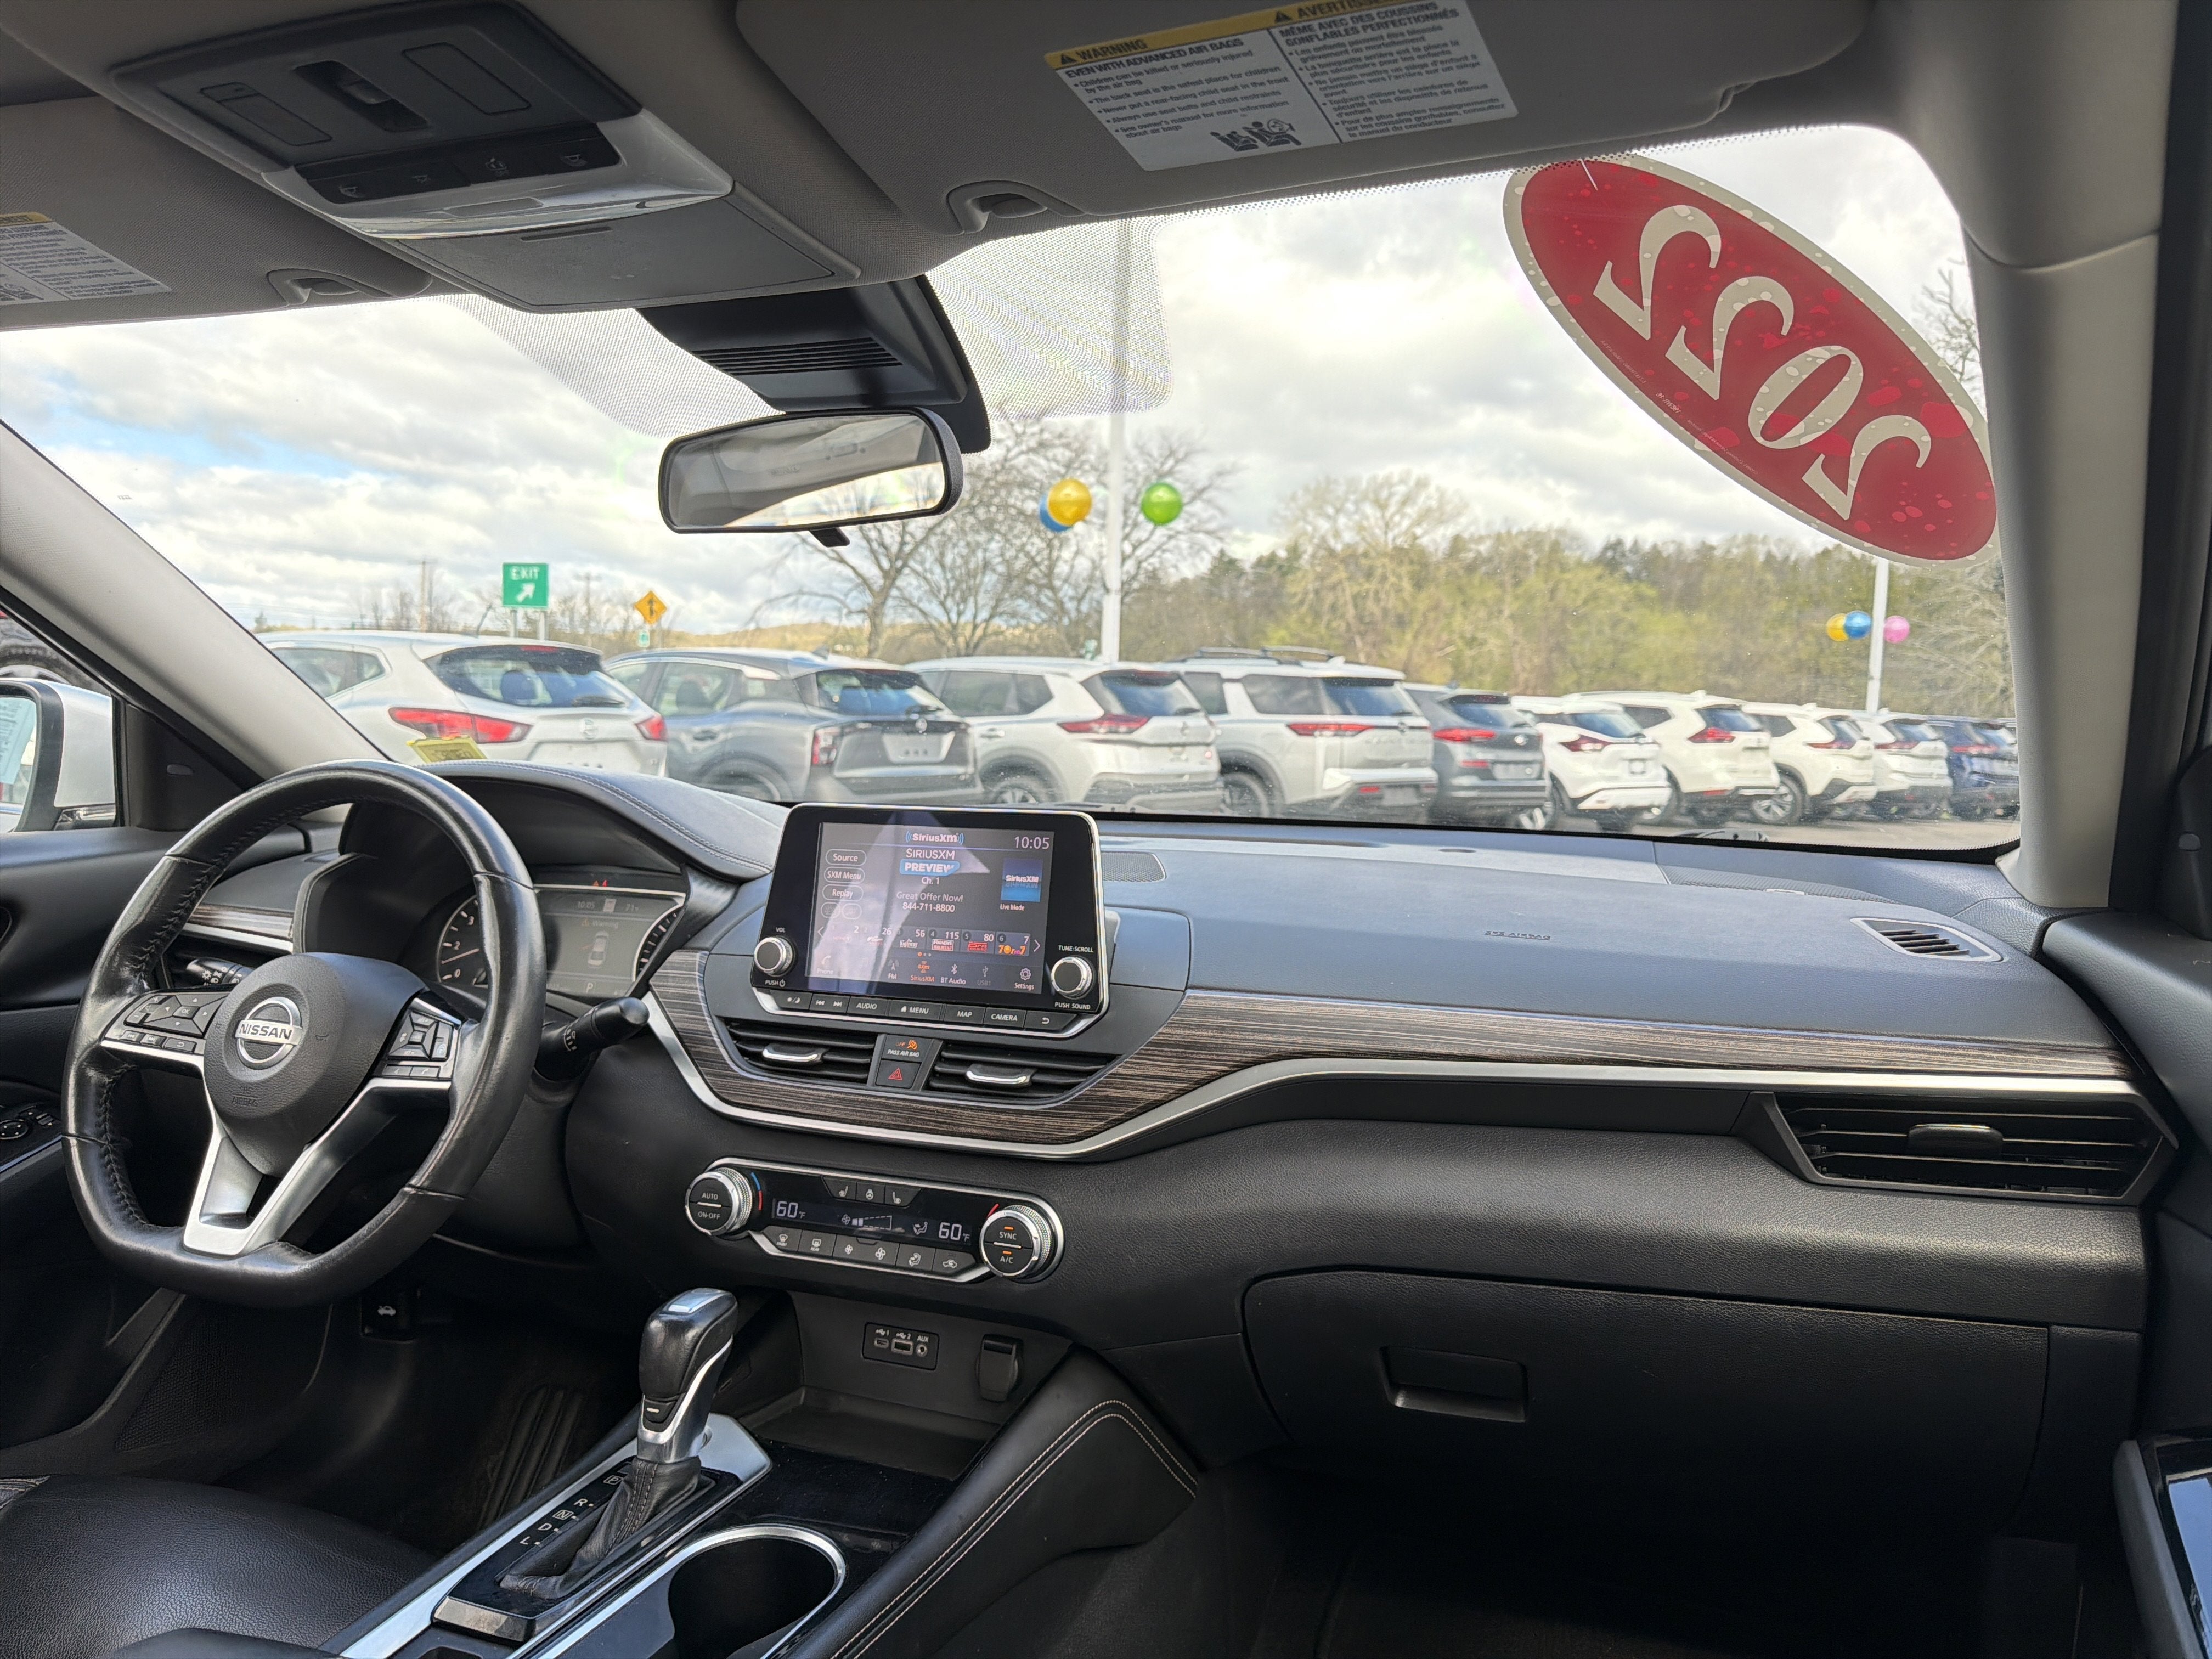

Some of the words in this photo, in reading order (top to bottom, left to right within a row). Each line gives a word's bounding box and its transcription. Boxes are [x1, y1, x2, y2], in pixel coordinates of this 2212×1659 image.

[1075, 40, 1148, 60] WARNING
[1065, 66, 1096, 78] EVEN
[1093, 60, 1126, 71] WITH
[1126, 49, 1187, 66] ADVANCED
[1188, 44, 1209, 54] AIR
[1209, 38, 1244, 50] BAGS
[511, 567, 540, 580] EXIT
[1014, 836, 1050, 849] 10:05
[833, 853, 858, 862] Source
[906, 848, 955, 860] SIRIUSXM
[905, 862, 955, 873] PREVIEW
[832, 889, 853, 899] Replay
[920, 893, 941, 901] Offer
[943, 894, 963, 902] Now!
[902, 902, 955, 912] 844-711-8800
[854, 926, 859, 934] 2
[916, 929, 925, 938] 56
[945, 931, 959, 940] 115
[1024, 936, 1029, 944] 7
[586, 983, 593, 994] P
[239, 1024, 292, 1040] NISSAN
[999, 1232, 1017, 1240] SYNC
[1000, 1255, 1014, 1263] A/C
[574, 1498, 588, 1506] R
[538, 1522, 552, 1531] D
[520, 1536, 531, 1545] L
